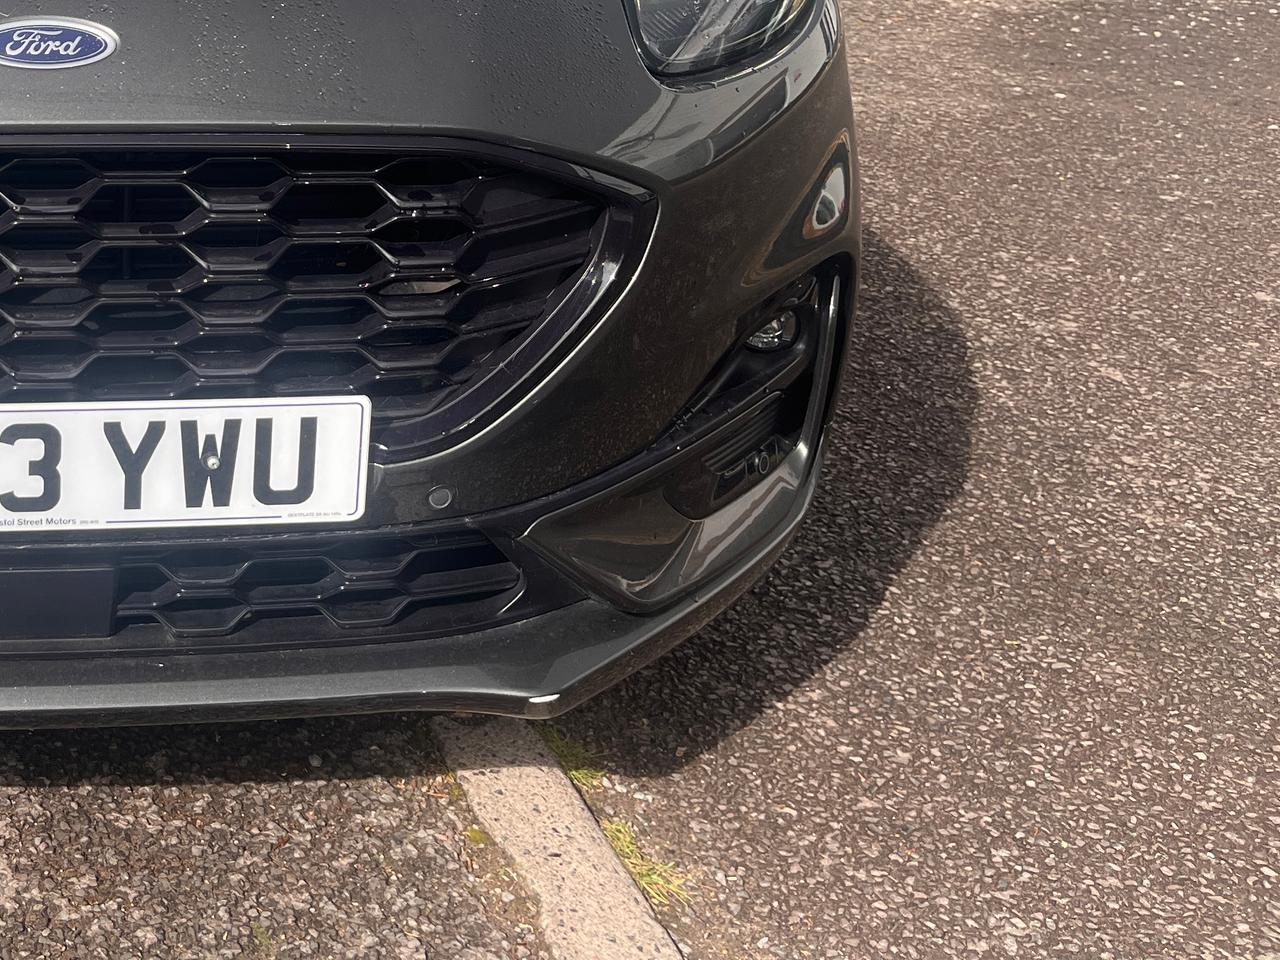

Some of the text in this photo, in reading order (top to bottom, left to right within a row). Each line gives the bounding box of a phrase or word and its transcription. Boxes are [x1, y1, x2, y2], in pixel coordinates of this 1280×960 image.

[5, 29, 82, 56] Ford
[103, 416, 319, 510] YWU
[17, 518, 43, 526] Street
[45, 517, 77, 526] Motors
